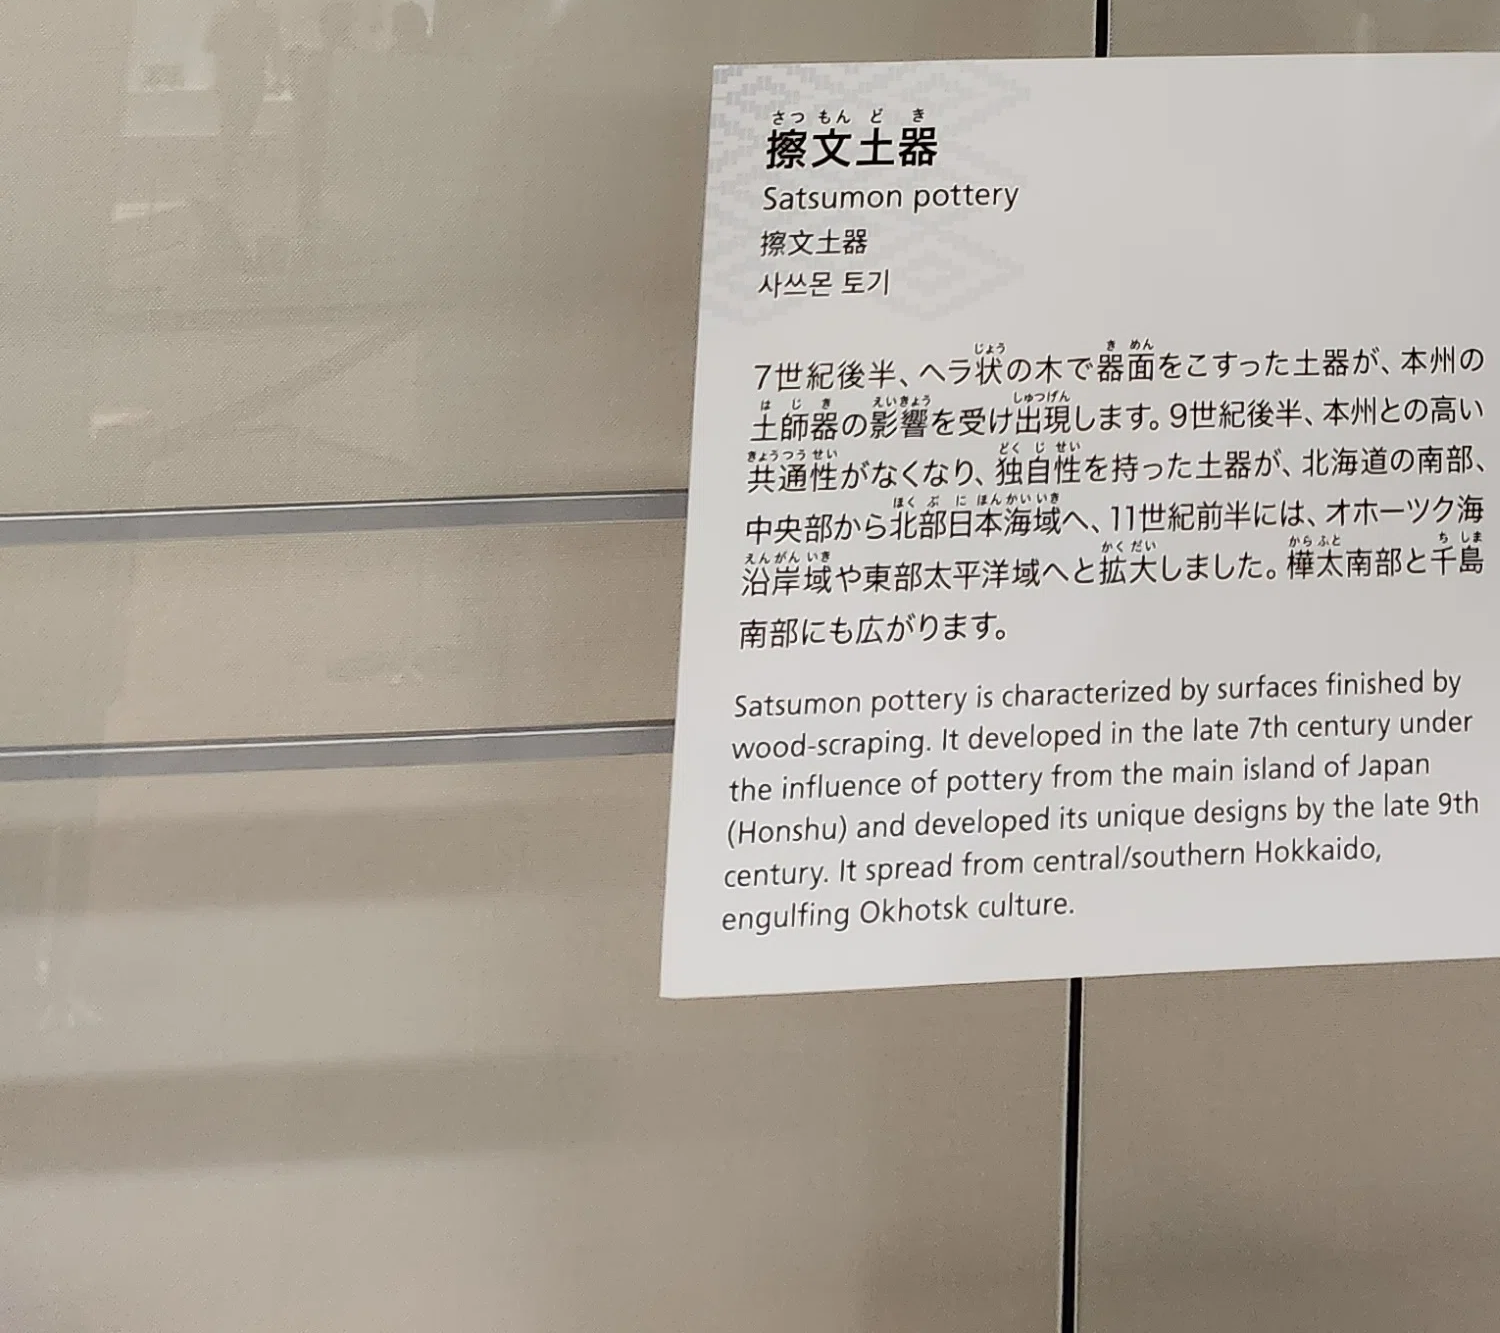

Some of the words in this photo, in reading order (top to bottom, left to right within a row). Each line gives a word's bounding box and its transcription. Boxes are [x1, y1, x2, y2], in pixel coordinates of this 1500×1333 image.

[766, 127, 938, 170] 擦文土器
[763, 186, 902, 211] Satsumon
[914, 183, 1020, 214] pottery
[760, 228, 868, 257] 擦文土器
[758, 271, 833, 299] 사쓰몬
[841, 269, 890, 296] 토기
[738, 611, 1007, 650] 南部にも広がります。
[734, 694, 861, 718] Satsumon
[871, 689, 967, 718] pottery
[977, 685, 993, 708] is
[1002, 677, 1171, 707] characterized
[1180, 676, 1210, 707] by
[1217, 674, 1318, 700] surfaces
[1325, 669, 1424, 696] finished
[1433, 668, 1462, 699] by
[731, 729, 931, 760] wood-scraping.
[942, 728, 959, 751] It
[968, 720, 1101, 753] developed
[1111, 720, 1132, 744] in
[1141, 719, 1183, 744] the
[1193, 717, 1239, 742] late
[1248, 714, 1288, 739] 7th
[1297, 715, 1391, 742] century
[1400, 709, 1473, 735] under
[729, 777, 772, 802] the
[782, 773, 901, 800] influence
[911, 768, 938, 794] of
[946, 769, 1043, 799] pottery
[1051, 763, 1112, 788] from
[1121, 760, 1163, 786] the
[1173, 758, 1233, 783] main
[1244, 754, 1315, 781] island
[1324, 752, 1350, 778] of
[1358, 754, 1429, 782] Japan
[727, 815, 847, 849] (Honshu)
[857, 812, 905, 839] and
[915, 805, 1050, 839] developed
[1060, 806, 1088, 830] its
[1097, 803, 1185, 832] unique
[1194, 798, 1287, 829] designs
[1296, 795, 1325, 826] by
[1332, 794, 1374, 819] the
[1384, 792, 1430, 817] late
[1438, 790, 1479, 815] 9th
[724, 864, 828, 891] century.
[840, 859, 857, 882] It
[866, 852, 952, 887] spread
[961, 851, 1024, 876] from
[1033, 841, 1245, 873] central/southern
[1256, 835, 1381, 863] Hokkaido,
[722, 901, 849, 936] engulfing
[860, 894, 968, 924] Okhotsk
[978, 892, 1074, 919] culture.
